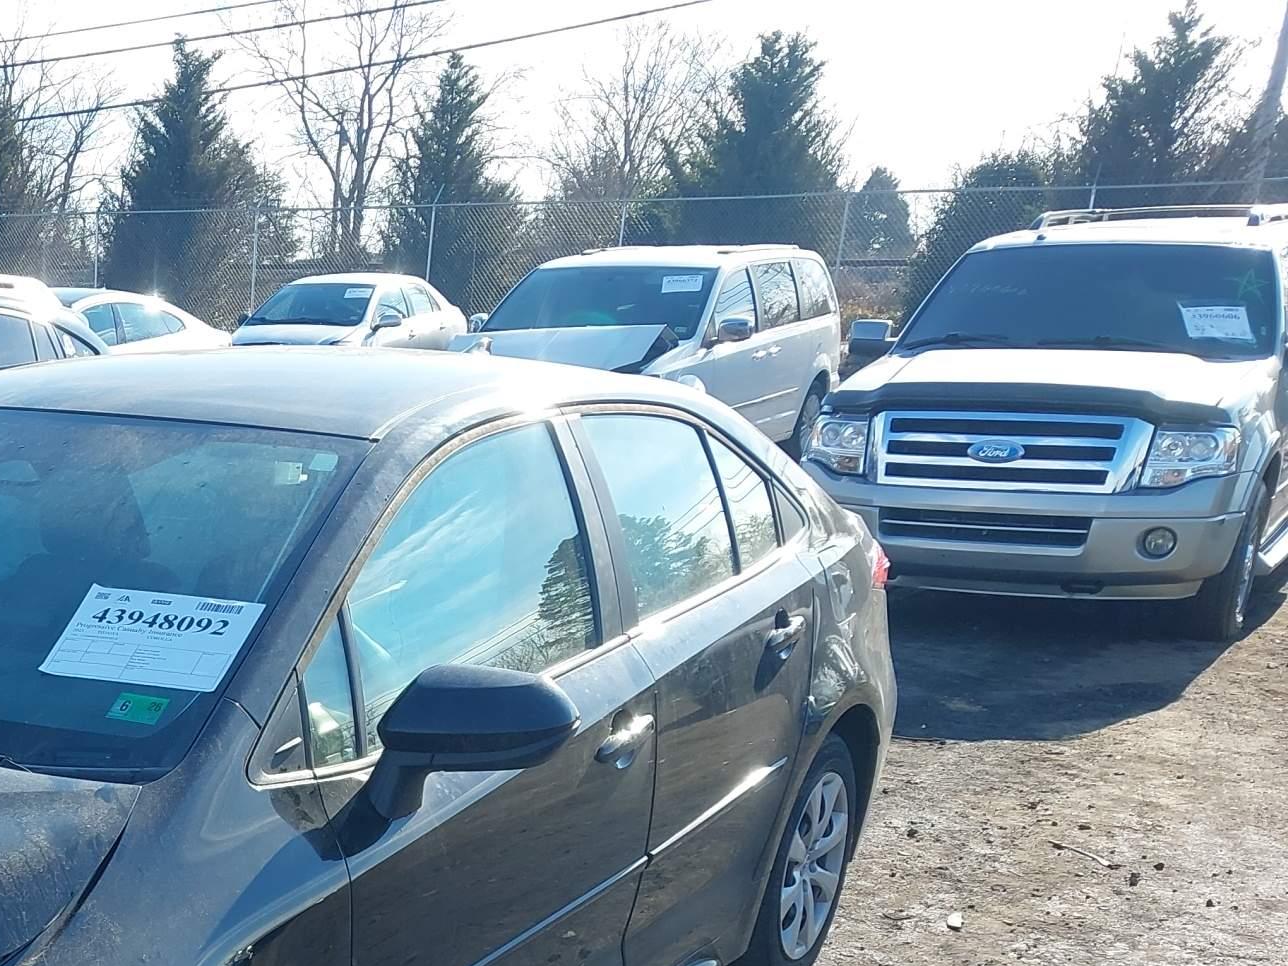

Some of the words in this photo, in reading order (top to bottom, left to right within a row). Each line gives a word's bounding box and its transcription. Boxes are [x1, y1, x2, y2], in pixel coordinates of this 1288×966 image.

[978, 444, 1010, 457] Ford
[92, 607, 230, 636] 43948092
[119, 699, 132, 712] 6
